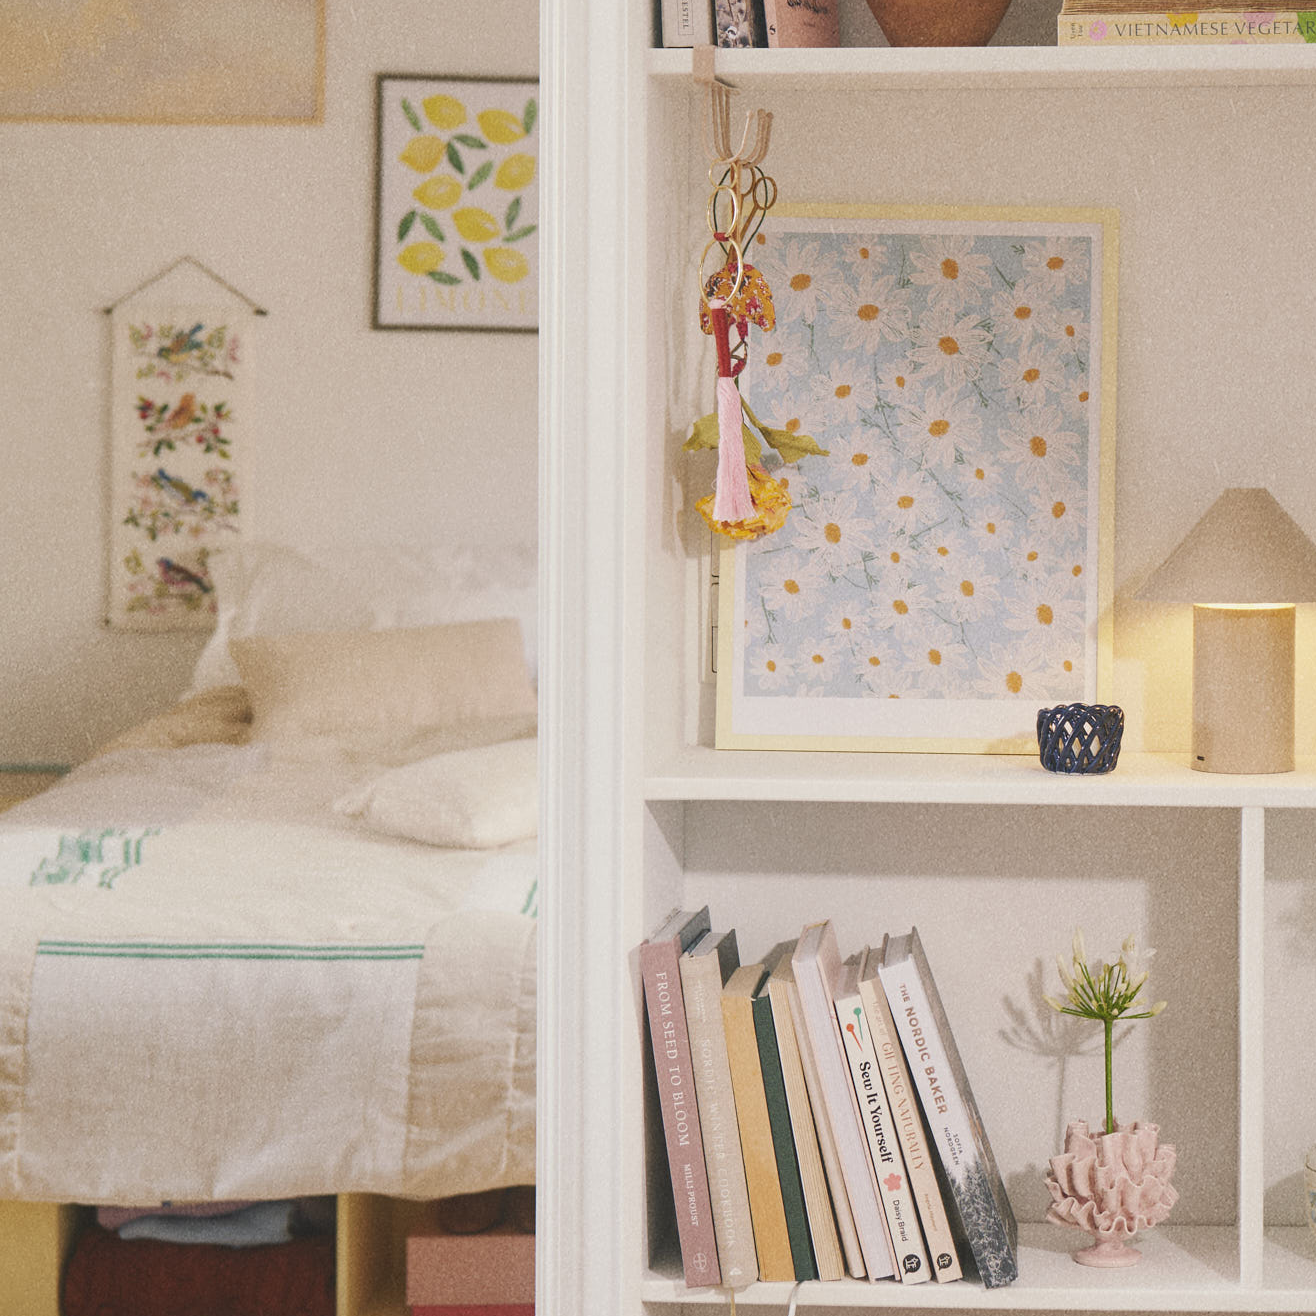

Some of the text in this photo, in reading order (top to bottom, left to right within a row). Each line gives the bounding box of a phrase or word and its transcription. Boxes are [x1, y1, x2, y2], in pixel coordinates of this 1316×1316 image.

[1114, 21, 1228, 37] VIETNAMESE
[656, 972, 690, 1146] FROM SEED TO BLOOM
[899, 983, 948, 1114] THE NORDIC BAKER
[710, 1103, 726, 1158] WINTER
[860, 1061, 894, 1163] Sew It Yourself
[881, 1043, 904, 1095] GIFTING
[898, 1098, 924, 1170] NATURALLY
[943, 1126, 960, 1166] NORDGREN
[953, 1133, 963, 1154] SOFIA
[688, 1191, 699, 1227] PROUST
[893, 1199, 908, 1242] Daisy Braid
